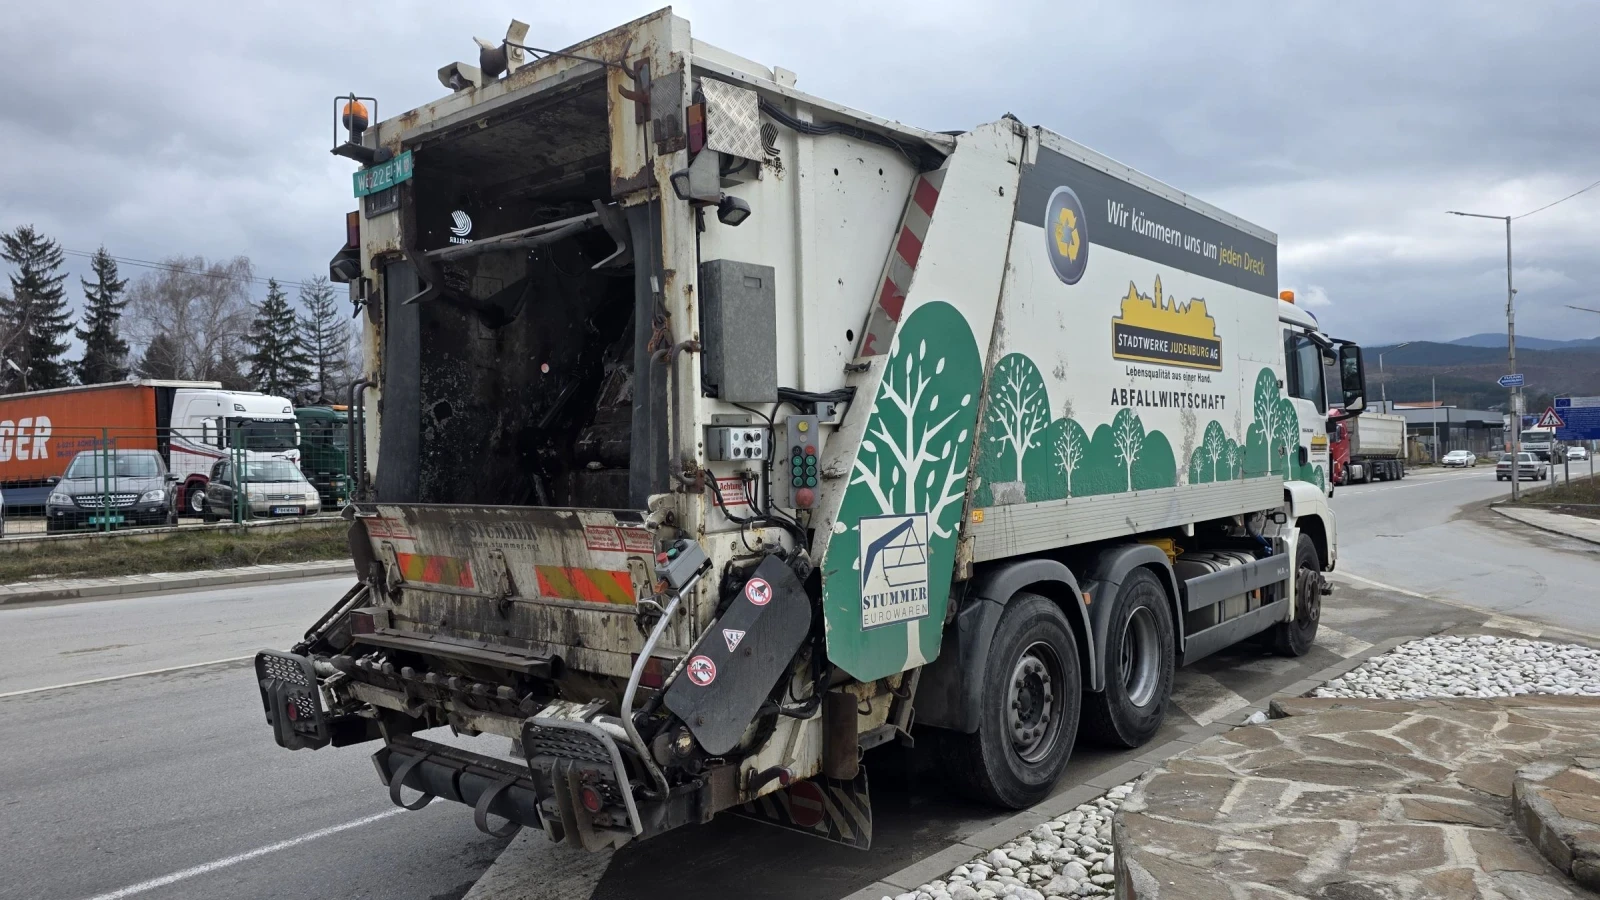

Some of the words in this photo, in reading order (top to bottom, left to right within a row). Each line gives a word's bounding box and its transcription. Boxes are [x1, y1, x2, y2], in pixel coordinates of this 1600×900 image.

[1107, 198, 1129, 228] Wir
[1131, 207, 1182, 248] kümmern
[1184, 234, 1201, 255] uns
[1203, 241, 1217, 260] um
[1218, 241, 1242, 268] jeden
[1243, 252, 1265, 276] Dreck
[1118, 333, 1169, 353] STADTWERKE
[1170, 341, 1210, 358] JUDENBURG
[1209, 348, 1219, 360] AG
[1125, 364, 1171, 381] Lebensqualität
[1171, 372, 1182, 380] aus
[1182, 371, 1197, 382] einer
[1197, 372, 1212, 383] Hand.
[1110, 387, 1226, 410] ABFALLWIRTSCHAFT
[863, 587, 927, 610] STUMMER
[864, 604, 928, 625] EUROWAREN
